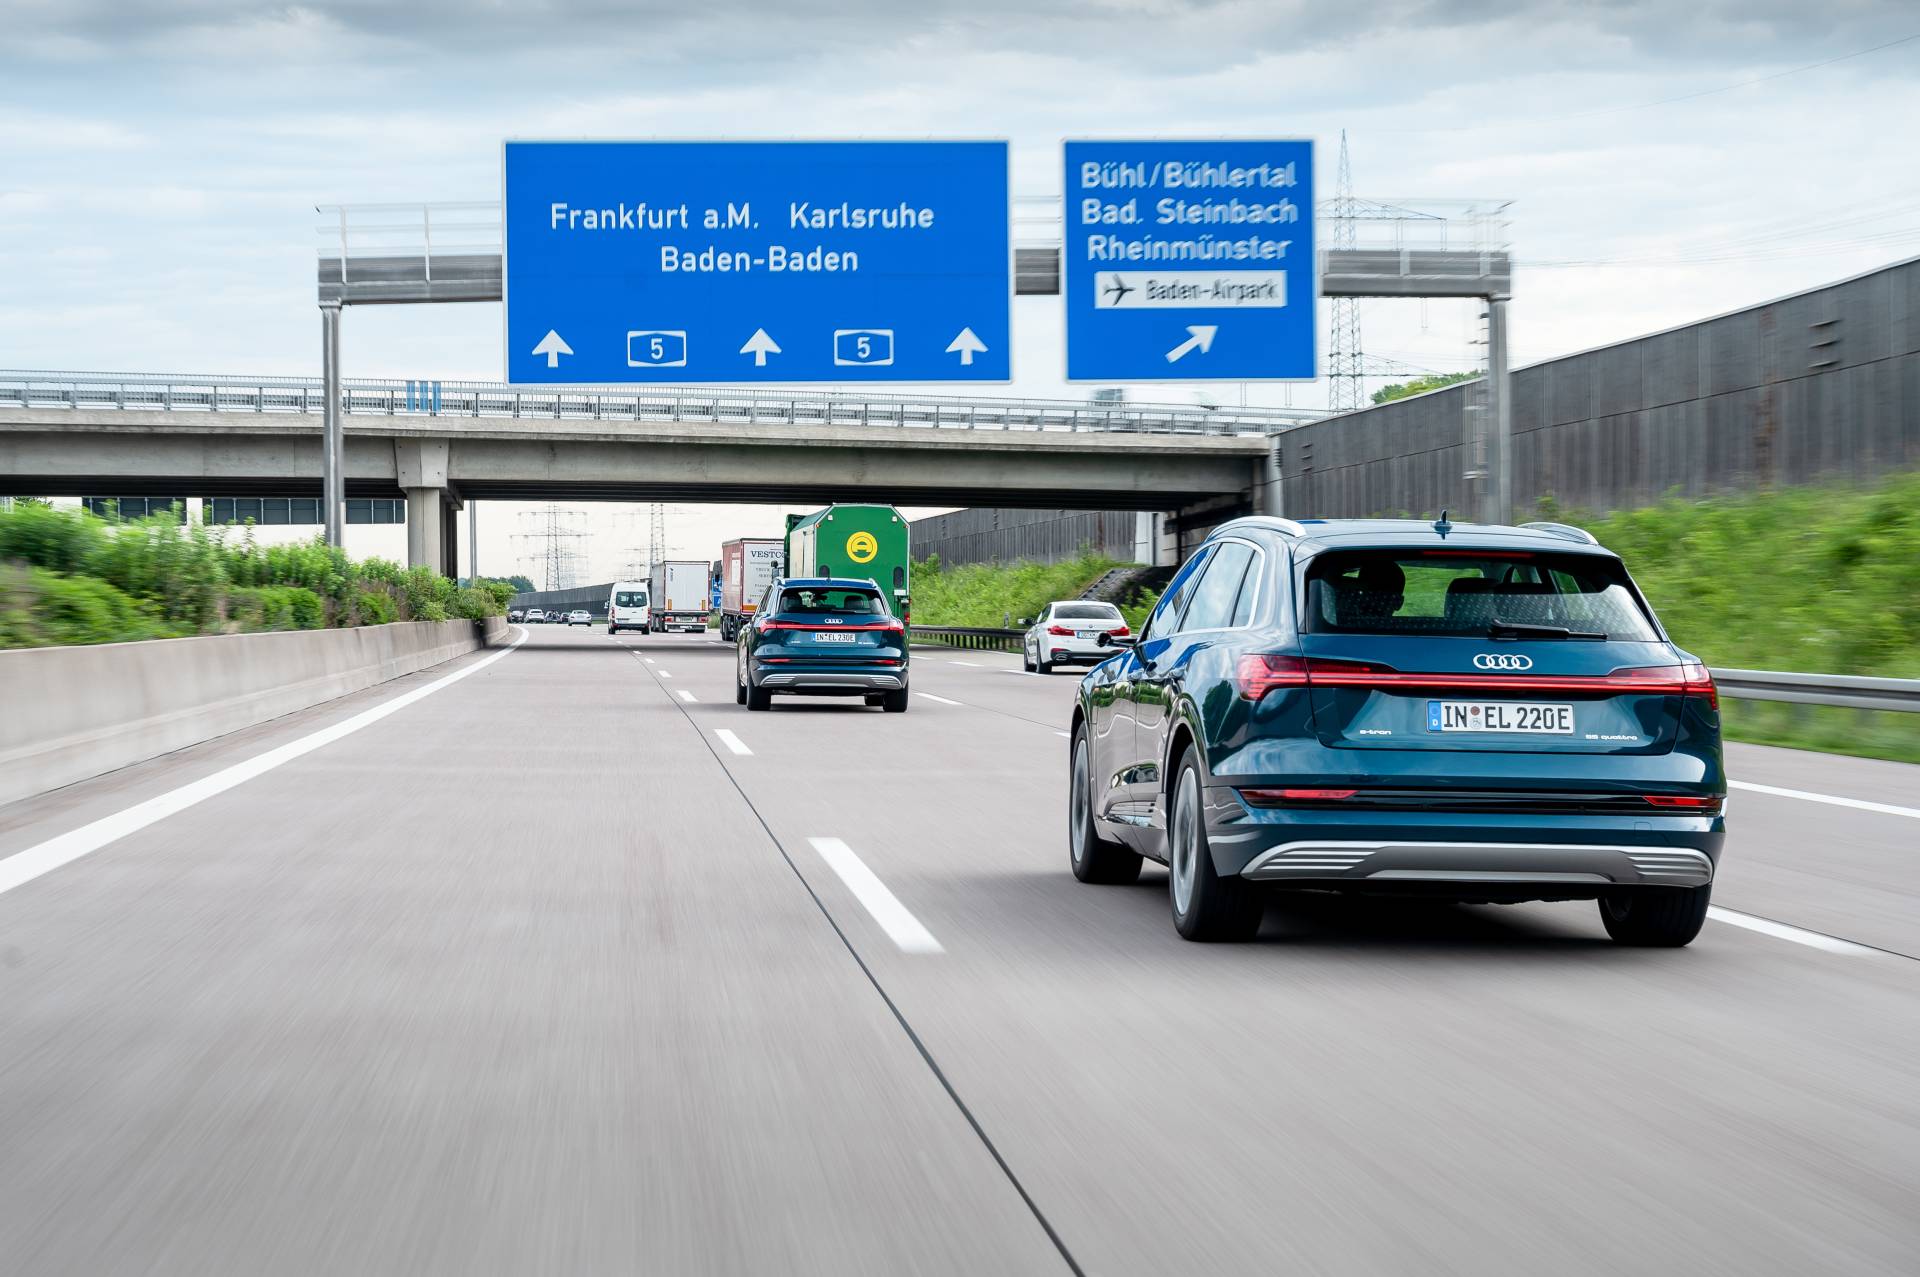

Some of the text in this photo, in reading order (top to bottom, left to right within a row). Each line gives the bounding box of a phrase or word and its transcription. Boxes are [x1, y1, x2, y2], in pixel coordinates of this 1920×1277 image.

[1081, 161, 1297, 189] Bühl/Bühlertal
[551, 202, 759, 230] Frankfurt a.M.
[790, 202, 935, 229] Karlsruhe
[1081, 197, 1298, 225] Bad. Steinbach
[661, 245, 858, 272] Baden-Baden
[1087, 234, 1293, 261] Rheinmünster
[1146, 279, 1279, 304] Baden-Airpark
[650, 337, 664, 360] 5
[857, 336, 871, 359] 5
[1443, 705, 1570, 730] IN EL 220E
